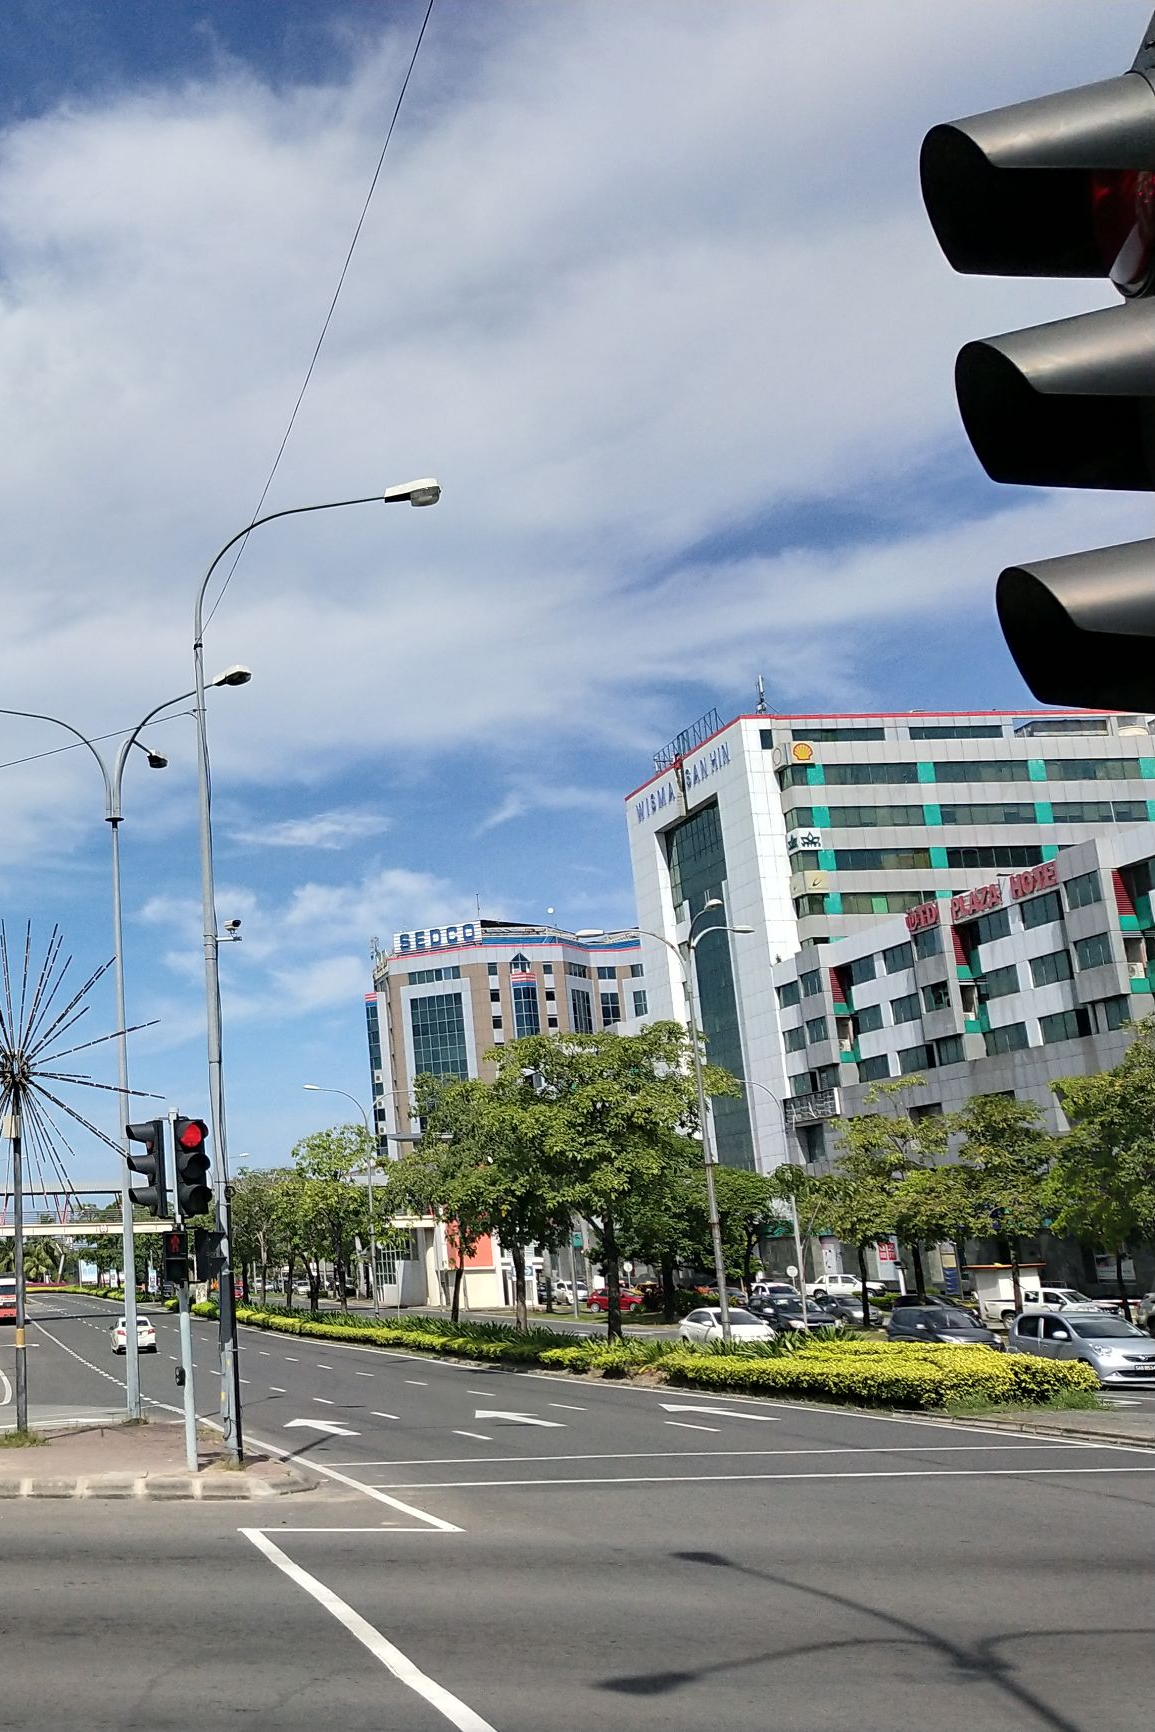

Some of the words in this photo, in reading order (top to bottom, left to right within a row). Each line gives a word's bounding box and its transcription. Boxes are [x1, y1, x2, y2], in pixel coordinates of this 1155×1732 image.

[635, 782, 676, 824] WISMA
[685, 757, 709, 792] SAN
[709, 741, 731, 775] HIN
[950, 882, 1003, 921] PLAZA
[1009, 858, 1058, 900] HOTE
[399, 923, 475, 952] SEDCO
